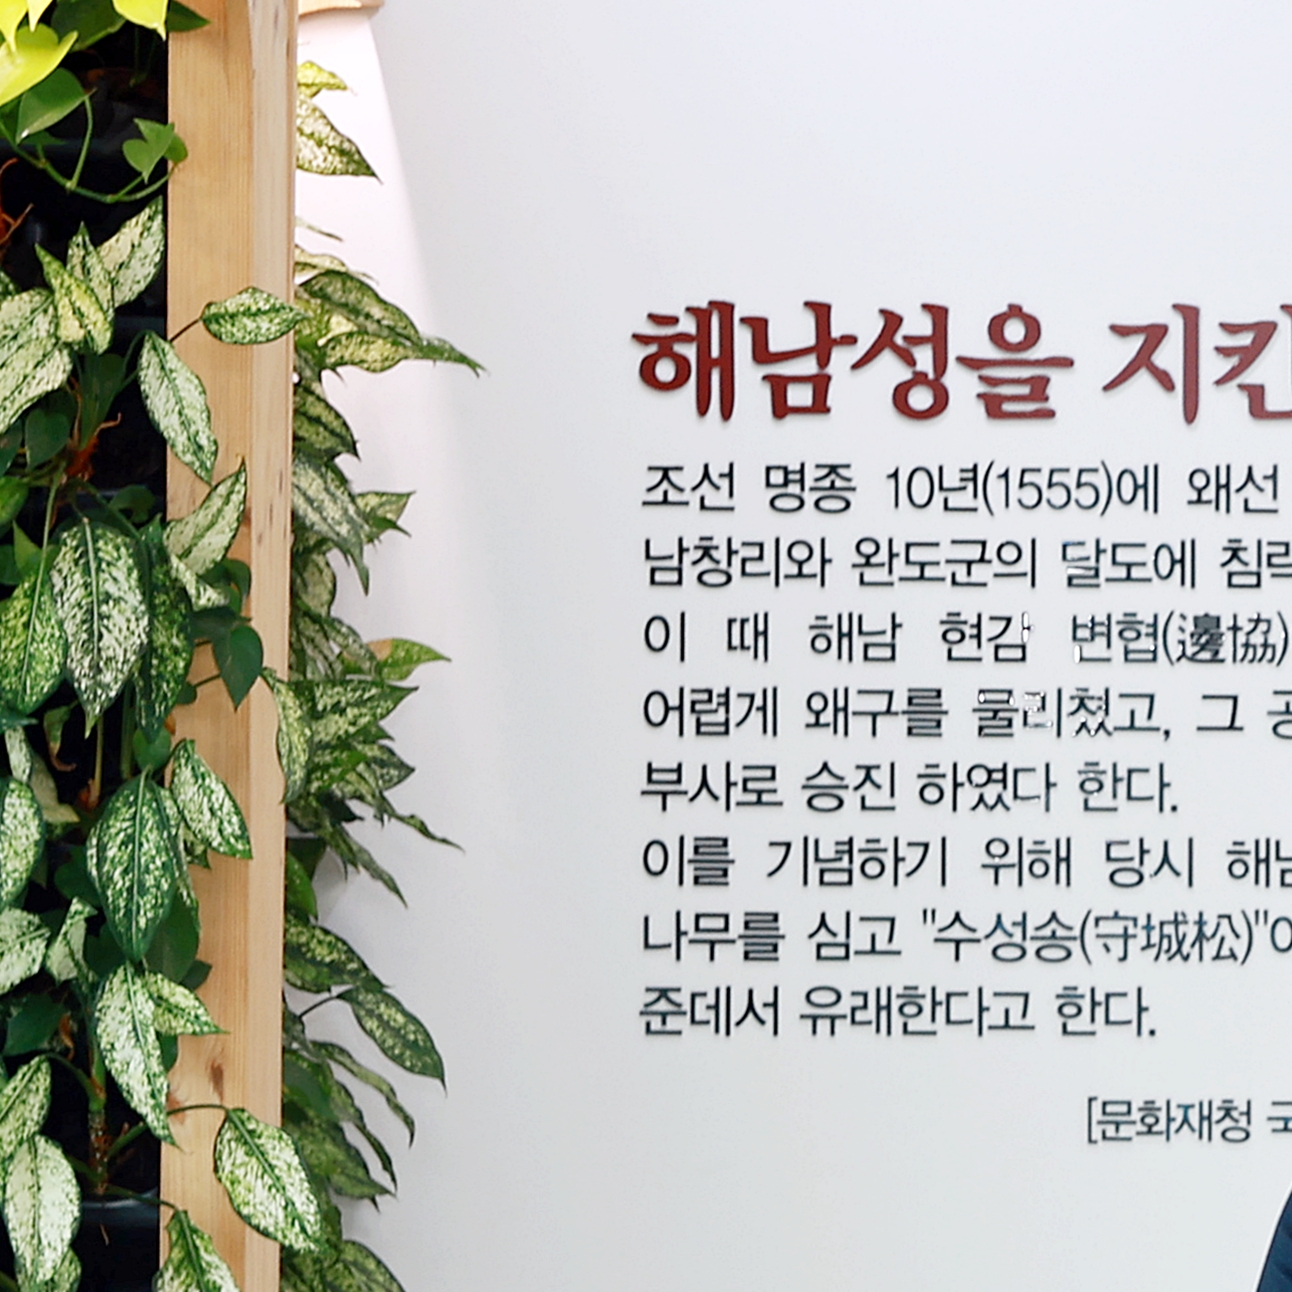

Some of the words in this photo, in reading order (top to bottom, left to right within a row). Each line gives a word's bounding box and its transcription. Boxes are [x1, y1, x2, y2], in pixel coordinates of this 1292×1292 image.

[630, 299, 1075, 424] 해남성을
[641, 461, 736, 513] 조선
[764, 461, 857, 515] 명종
[886, 460, 1159, 517] 10년(1555)에
[1186, 463, 1279, 515] 왜선
[644, 535, 833, 589] 남창리와
[850, 536, 1037, 590] 완도군의
[1061, 537, 1196, 590] 달도에
[643, 610, 686, 664] 이
[726, 610, 769, 664] 때
[808, 611, 904, 664] 해남
[938, 611, 1032, 664] 현감
[642, 685, 778, 739] 어렵게
[804, 685, 950, 739] 왜구를
[971, 686, 1171, 742] 물리쳤고,
[1195, 694, 1245, 732] 그
[639, 760, 784, 814] 부사로
[800, 760, 897, 814] 승진
[916, 761, 1058, 814] 하였다
[1077, 761, 1178, 814] 한다.
[642, 833, 736, 888] 이를
[766, 834, 947, 888] 기념하기
[980, 836, 1072, 889] 위해
[1105, 836, 1194, 889] 당시
[642, 909, 787, 963] 나무를
[807, 909, 903, 962] 심고
[638, 984, 780, 1038] 준데서
[798, 984, 1036, 1038] 유래한다고
[1054, 985, 1157, 1038] 한다.
[1087, 1095, 1252, 1145] [문화재청
